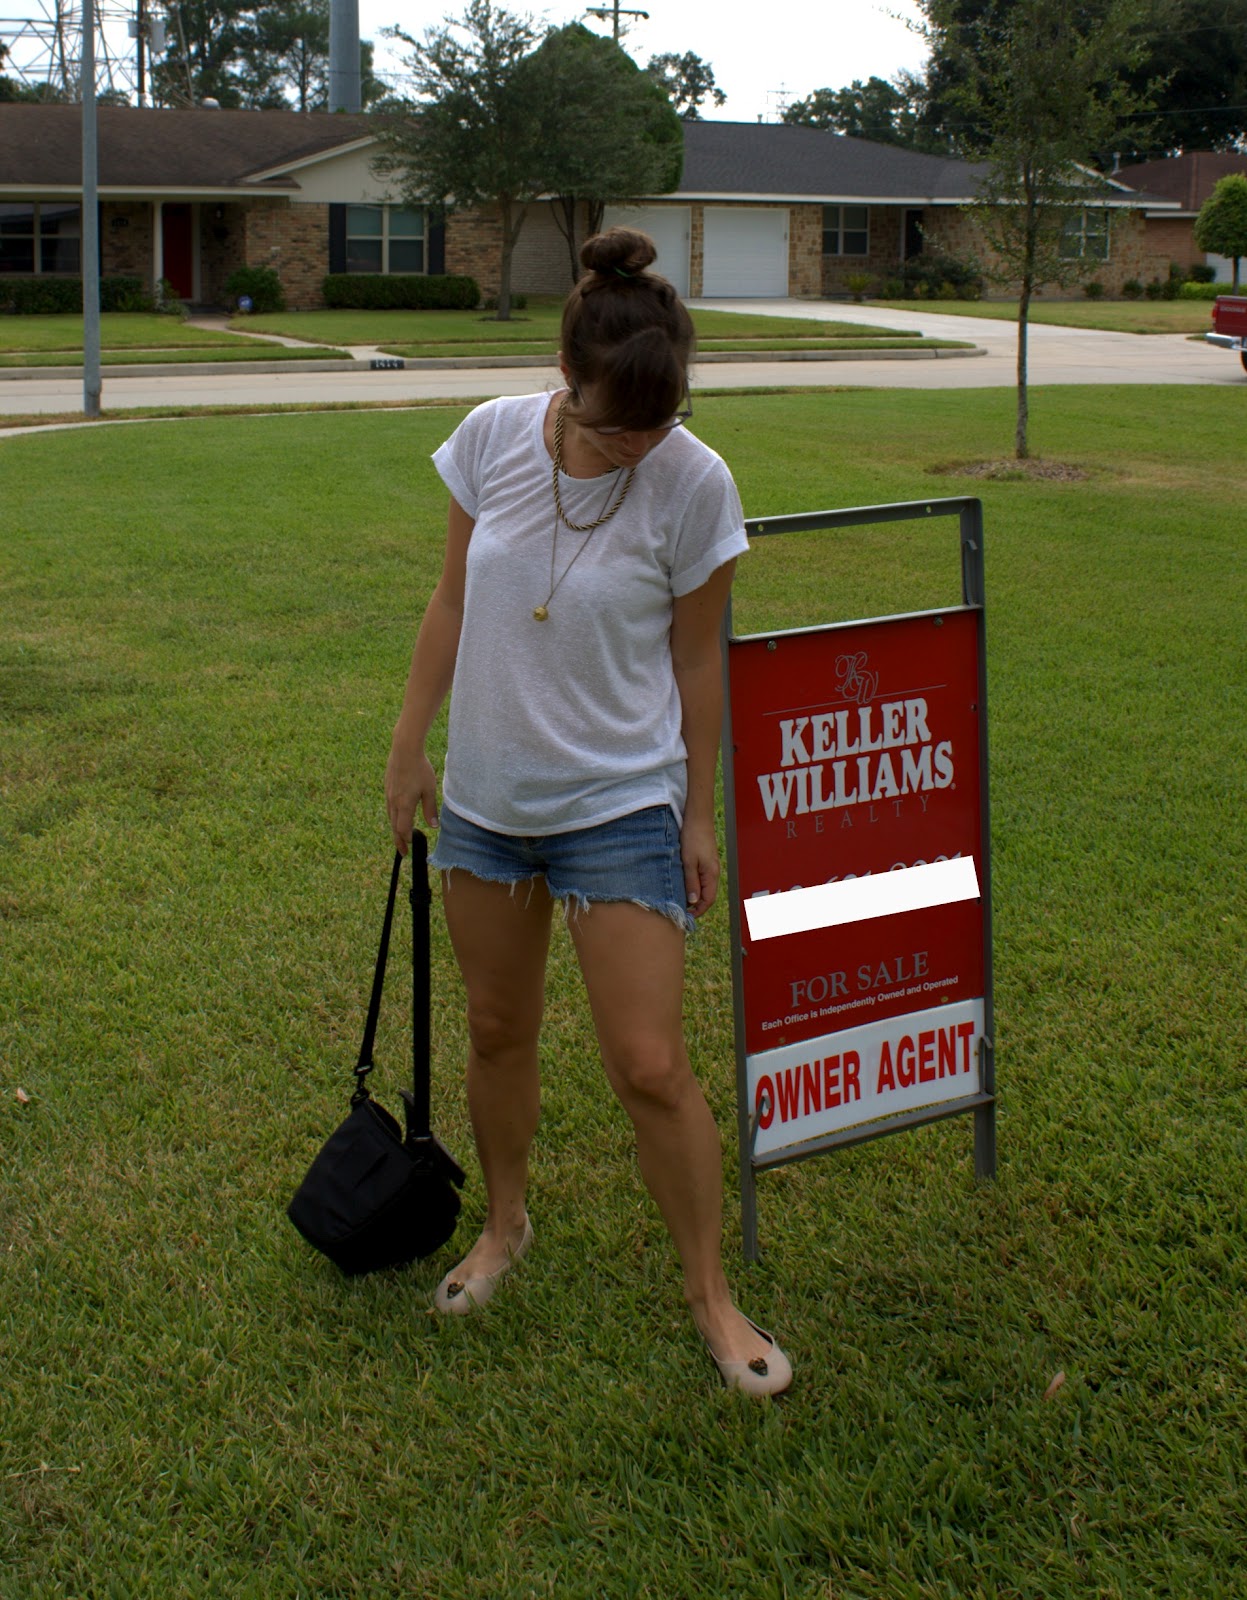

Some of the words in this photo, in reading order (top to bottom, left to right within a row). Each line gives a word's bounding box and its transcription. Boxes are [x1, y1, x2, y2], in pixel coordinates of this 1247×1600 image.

[779, 698, 932, 767] KELLER
[787, 795, 930, 839] REALTY
[761, 1018, 783, 1031] Each
[784, 1011, 809, 1025] Office
[810, 1007, 819, 1018] is
[819, 996, 876, 1015] Independently
[877, 988, 905, 1002] Owned
[906, 984, 922, 995] and
[922, 975, 959, 993] Operated
[790, 971, 850, 1008] FOR
[857, 951, 930, 990] SALE
[756, 1050, 861, 1130] OWNER
[877, 1021, 975, 1094] AGENT
